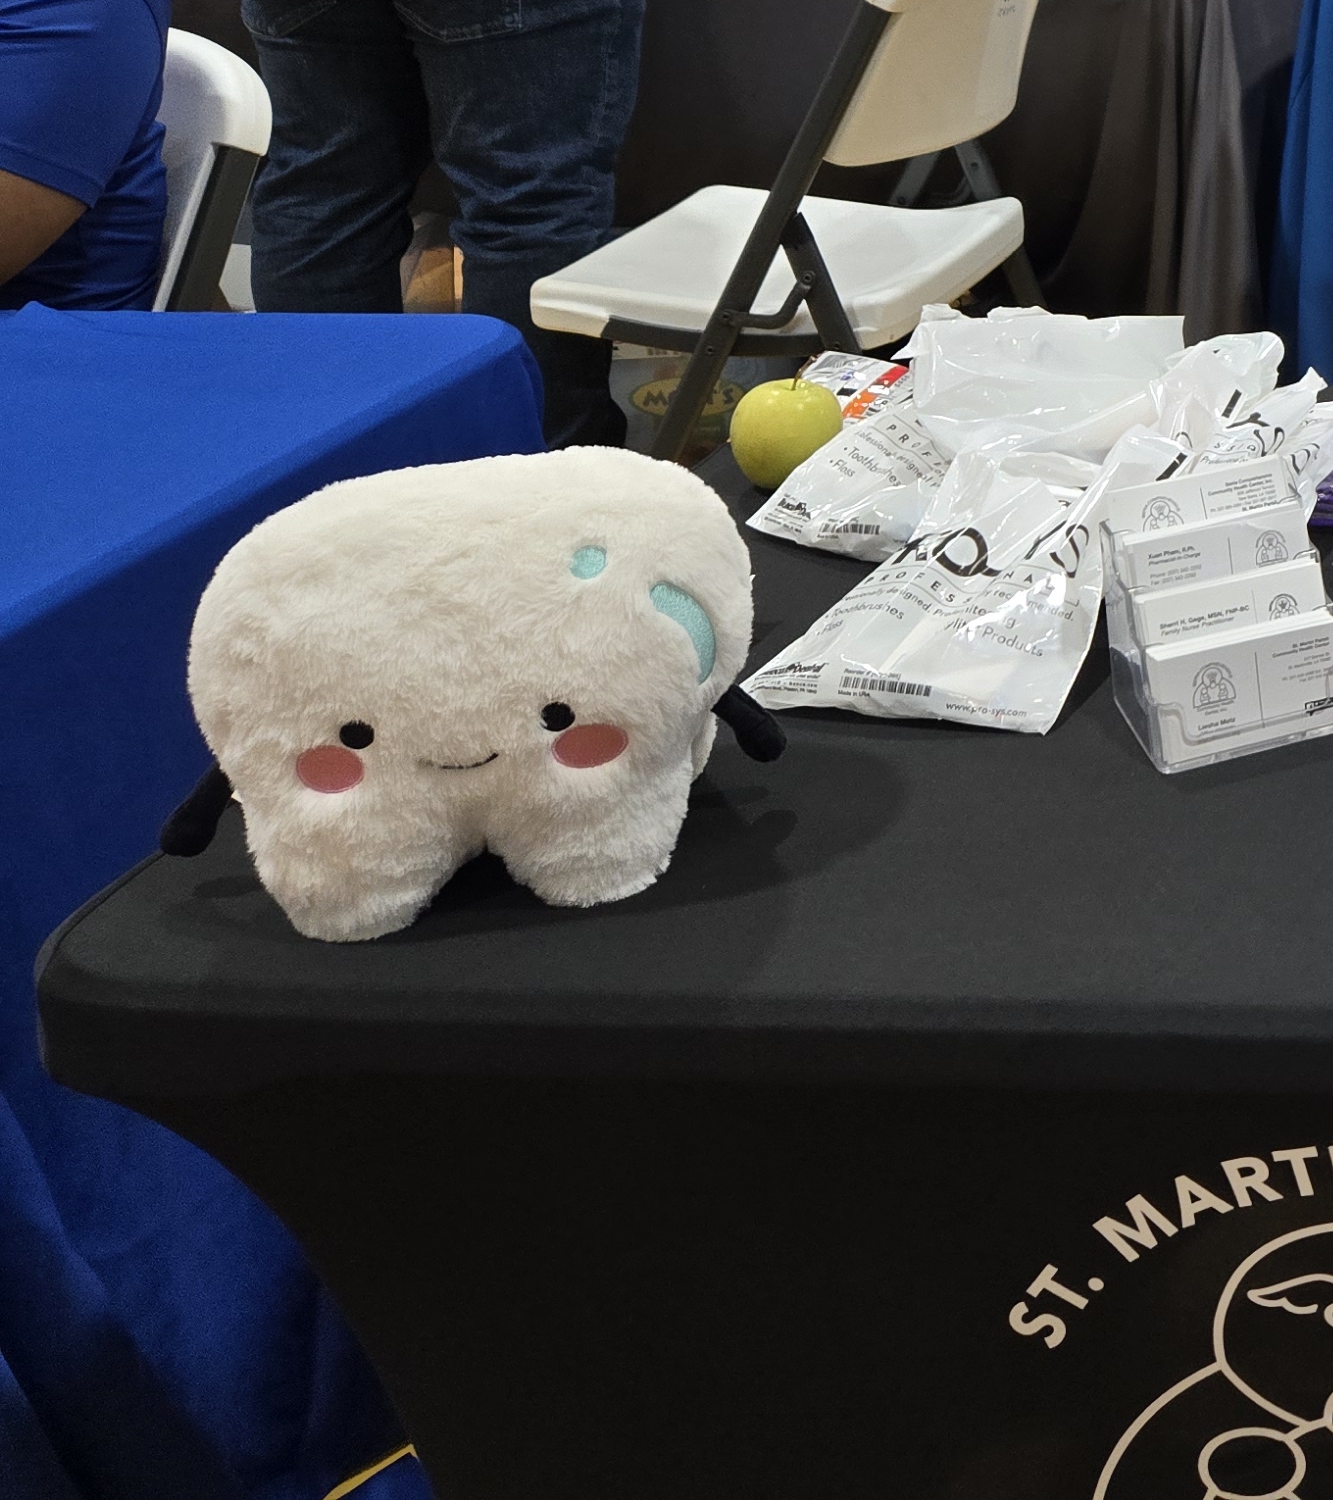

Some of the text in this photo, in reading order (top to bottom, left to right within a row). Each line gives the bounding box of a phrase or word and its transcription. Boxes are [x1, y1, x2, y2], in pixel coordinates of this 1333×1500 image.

[832, 457, 856, 479] Floss
[1181, 622, 1201, 633] Nurse
[1201, 614, 1235, 628] Practitioner
[981, 627, 1044, 658] Products
[945, 702, 1028, 718] www.pro-sys.com
[1008, 1263, 1105, 1350] ST.
